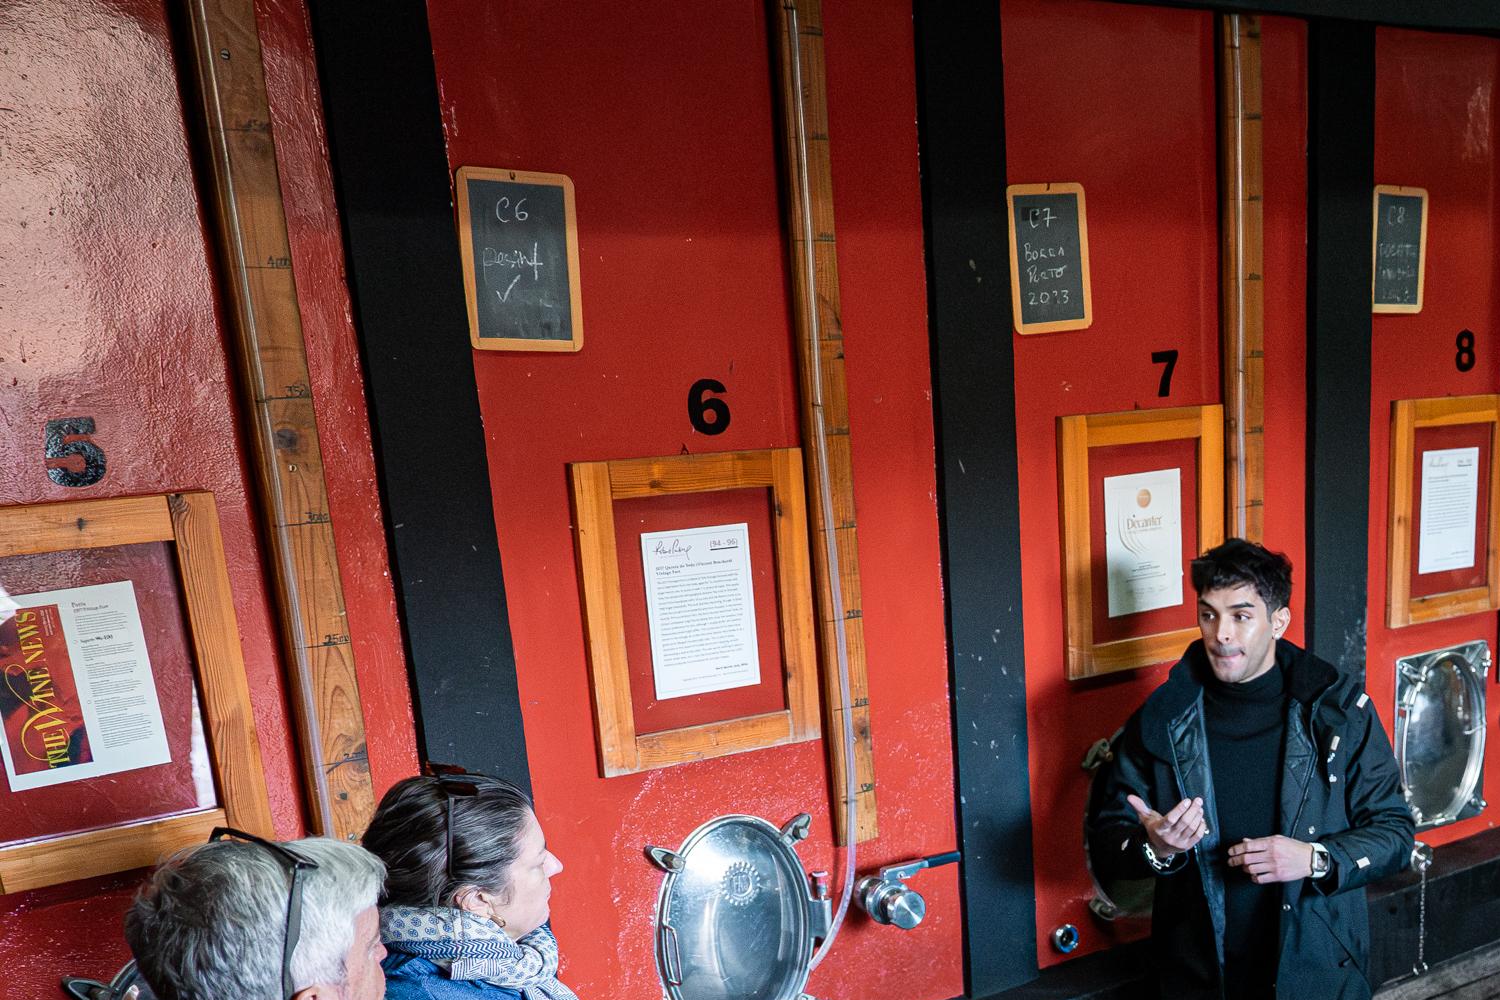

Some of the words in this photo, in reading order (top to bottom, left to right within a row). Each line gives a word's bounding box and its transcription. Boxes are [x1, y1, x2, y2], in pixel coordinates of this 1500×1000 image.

[496, 197, 529, 222] C6
[1029, 207, 1057, 228] C7
[1455, 330, 1475, 372] 8
[1151, 350, 1178, 397] 7
[688, 378, 731, 436] 6
[44, 416, 107, 488] 5
[15, 611, 46, 664] NEWS
[43, 728, 71, 769] THE
